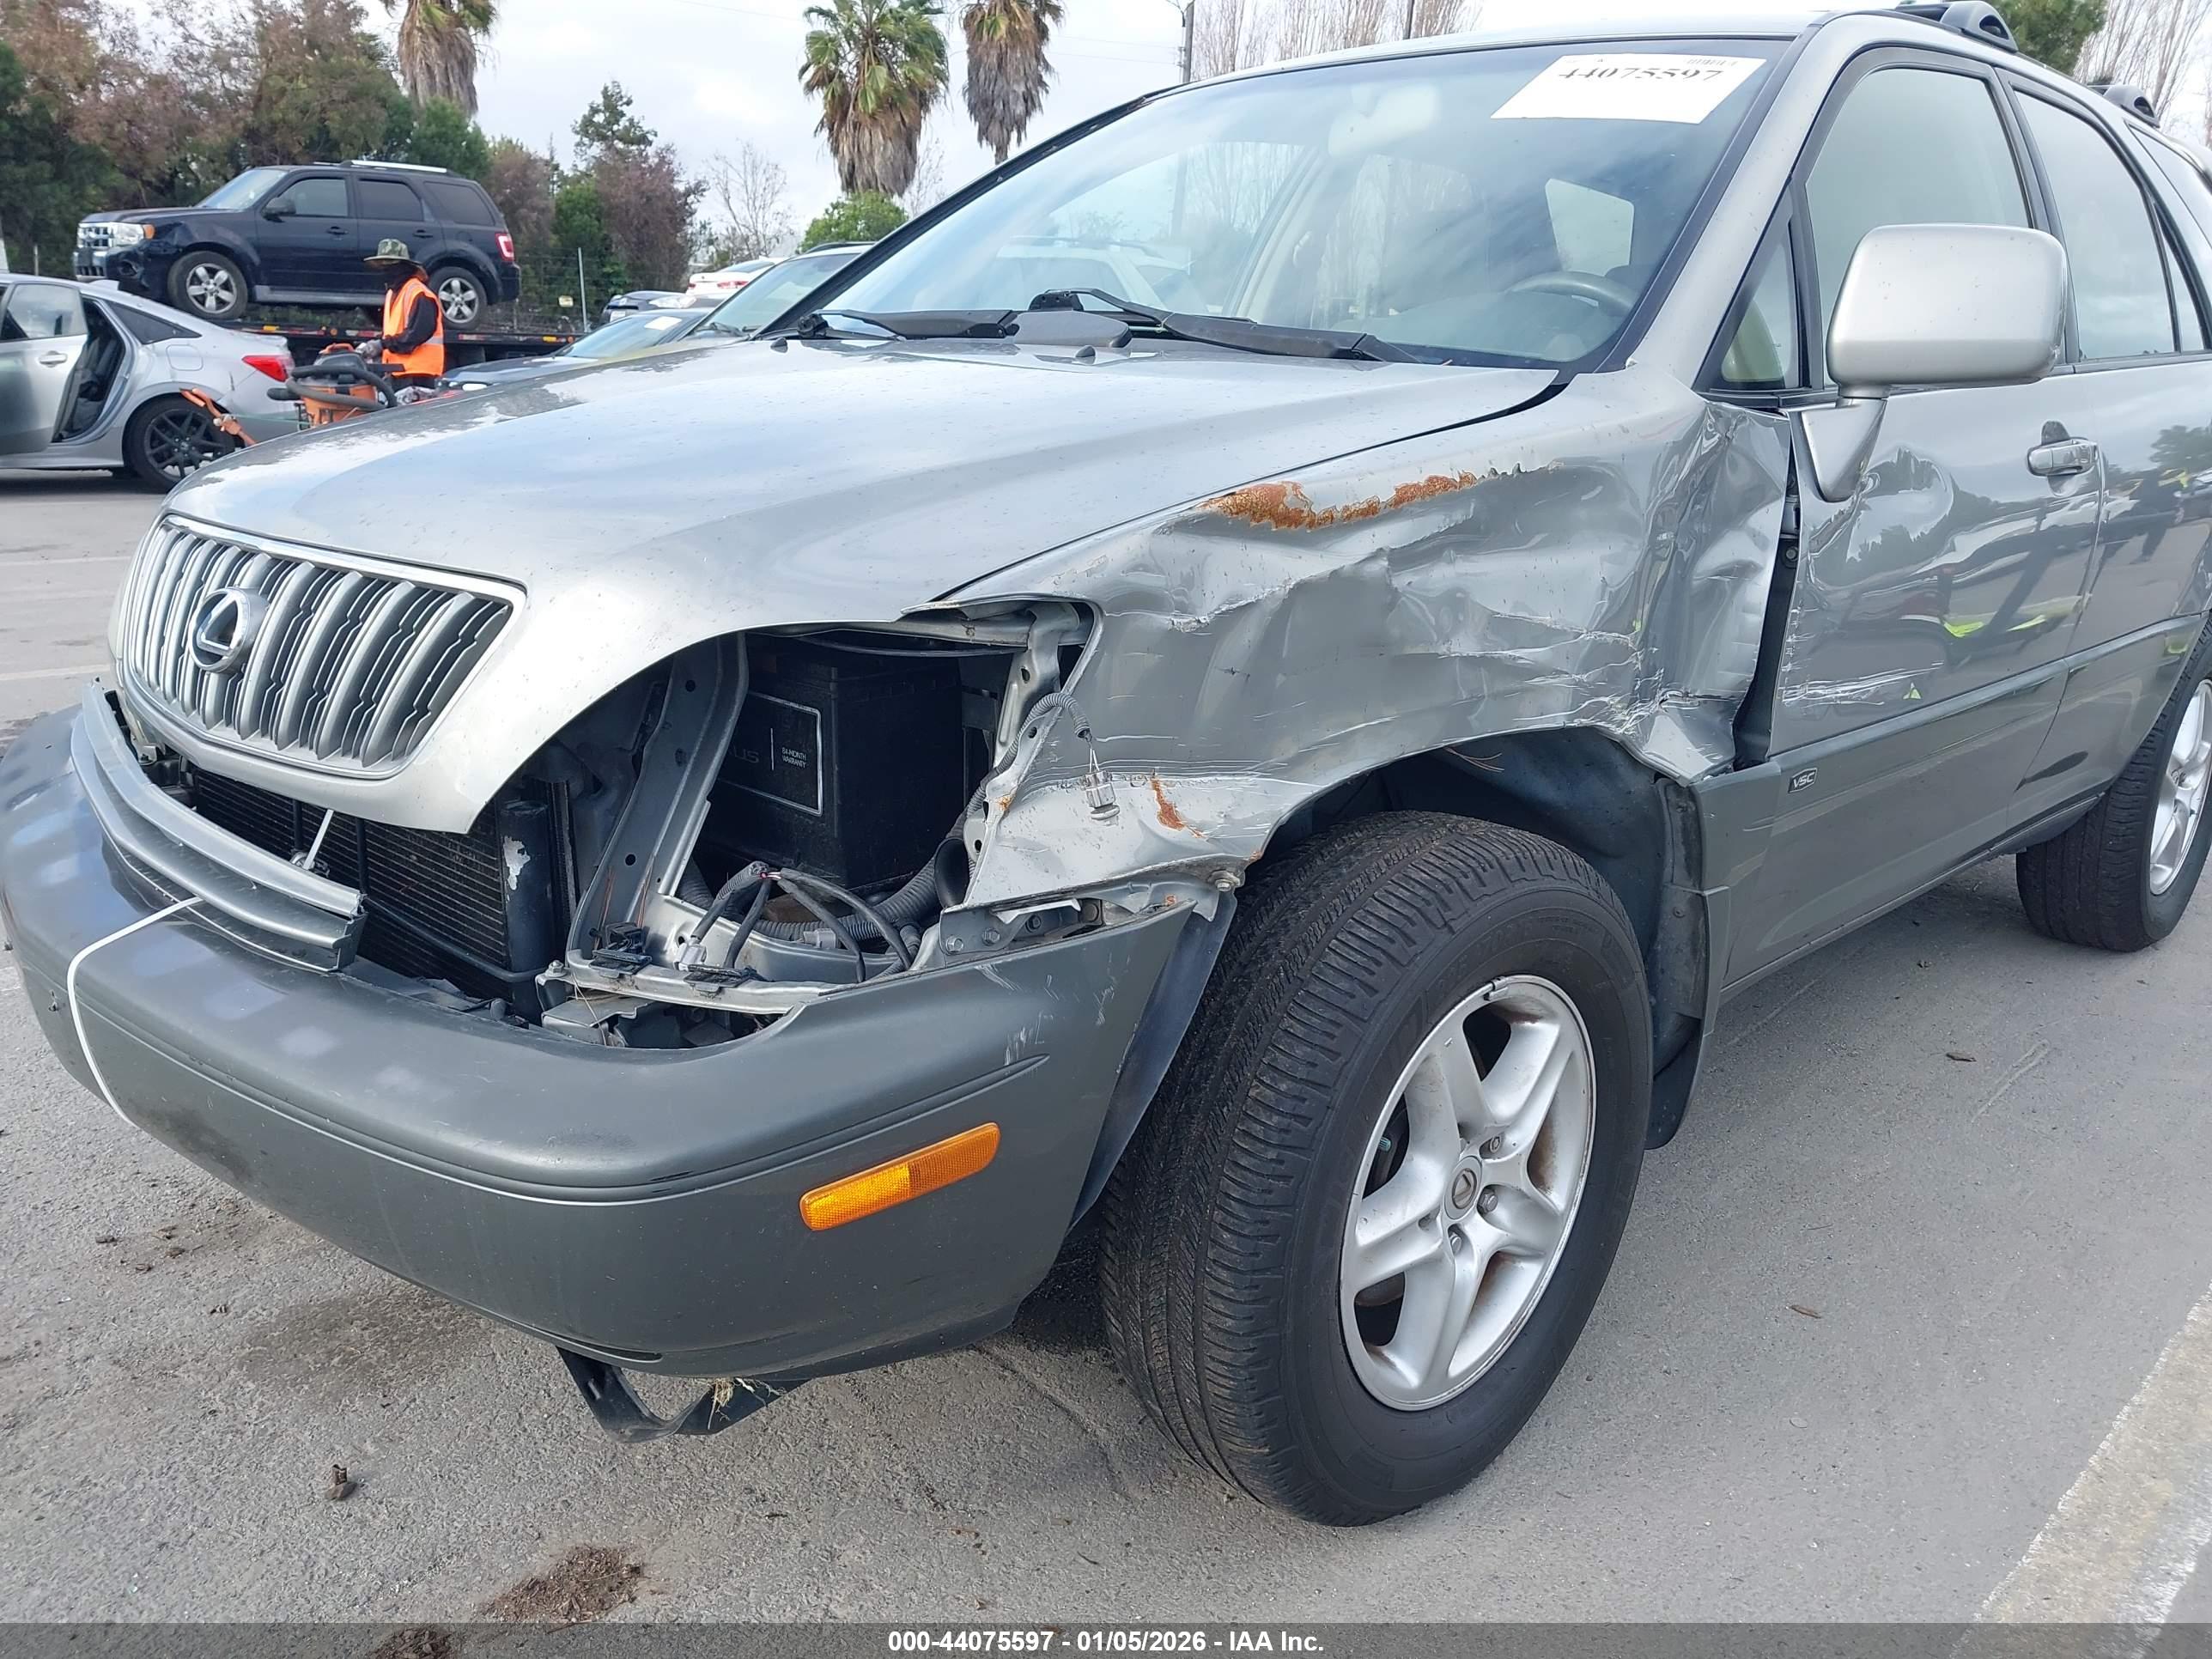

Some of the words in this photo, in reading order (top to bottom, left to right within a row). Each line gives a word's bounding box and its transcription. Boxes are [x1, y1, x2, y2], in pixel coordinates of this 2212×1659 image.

[1559, 67, 1724, 82] 44075597
[781, 755, 807, 769] WARRANTY
[1793, 771, 1815, 788] VSC
